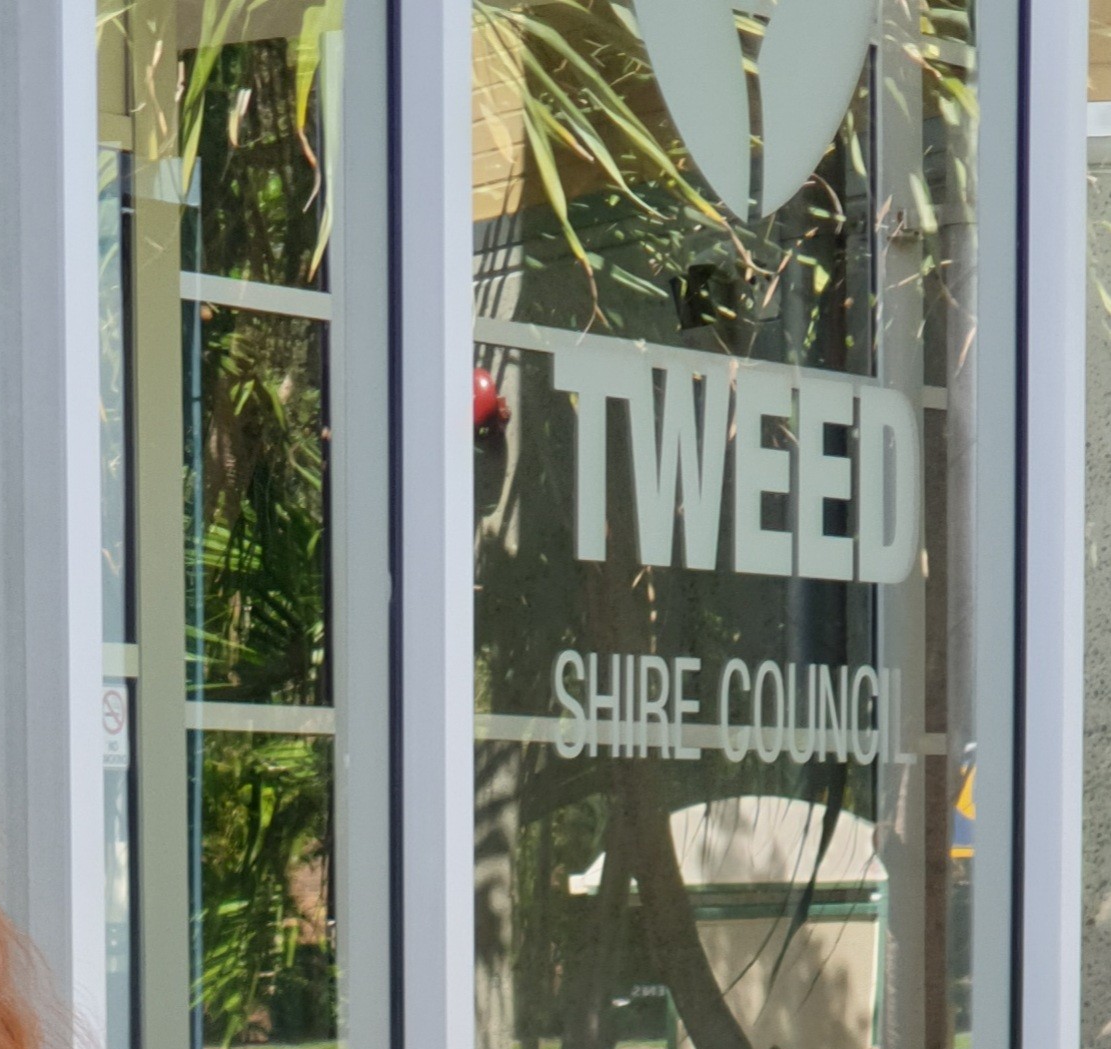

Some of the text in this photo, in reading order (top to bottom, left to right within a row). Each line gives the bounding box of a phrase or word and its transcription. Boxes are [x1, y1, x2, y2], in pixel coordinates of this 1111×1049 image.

[553, 351, 920, 584] TWEED
[554, 649, 917, 765] SHIRE COUNCIL
